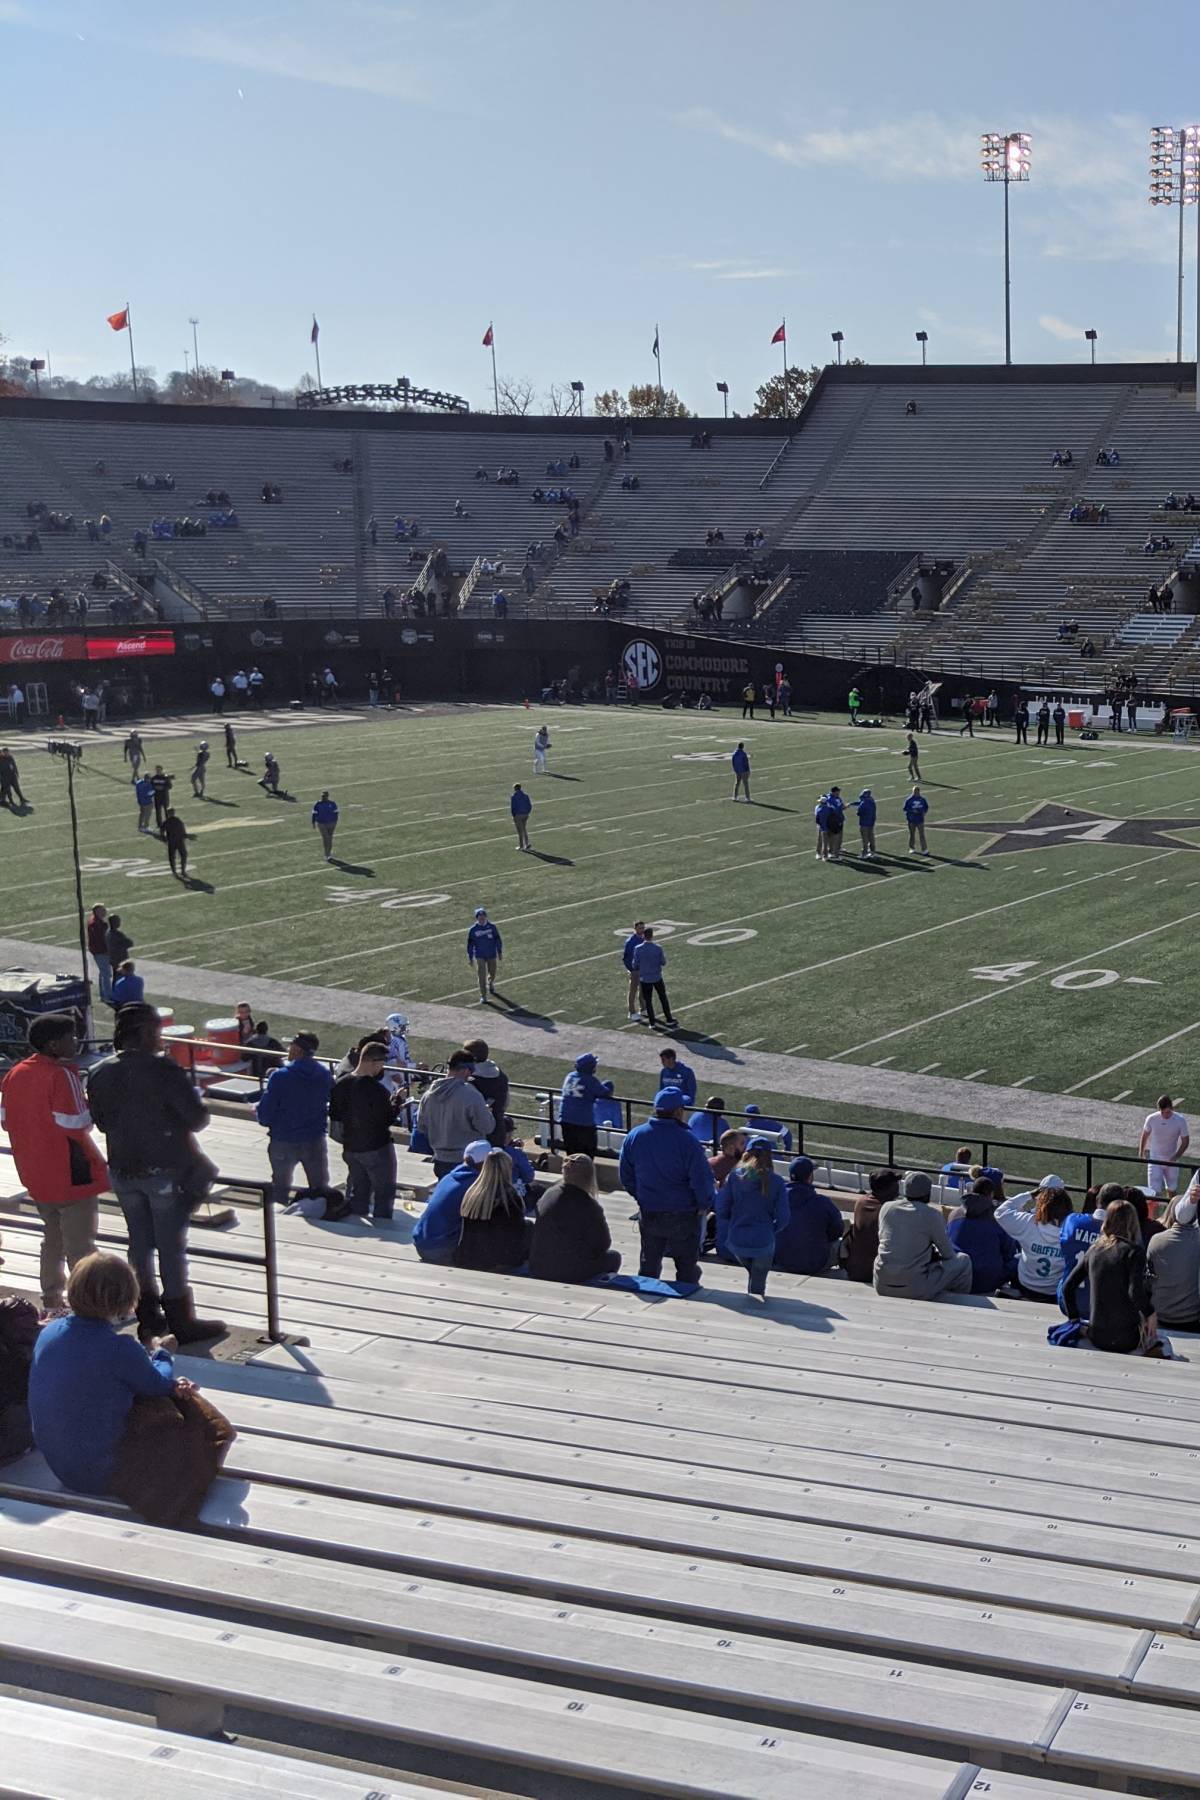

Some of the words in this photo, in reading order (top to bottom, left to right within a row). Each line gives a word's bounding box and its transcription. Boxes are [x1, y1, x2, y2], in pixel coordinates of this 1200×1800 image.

[116, 641, 146, 651] Ascend
[624, 641, 659, 689] SEC
[665, 655, 749, 673] COMMODORE
[666, 675, 731, 692] COUNTRY
[967, 960, 1121, 990] 40
[1075, 1228, 1100, 1244] WAG
[1035, 1257, 1052, 1277] 3
[566, 1701, 585, 1712] 10
[1073, 1702, 1089, 1711] 12
[760, 1738, 777, 1748] 11
[973, 1780, 991, 1792] 12
